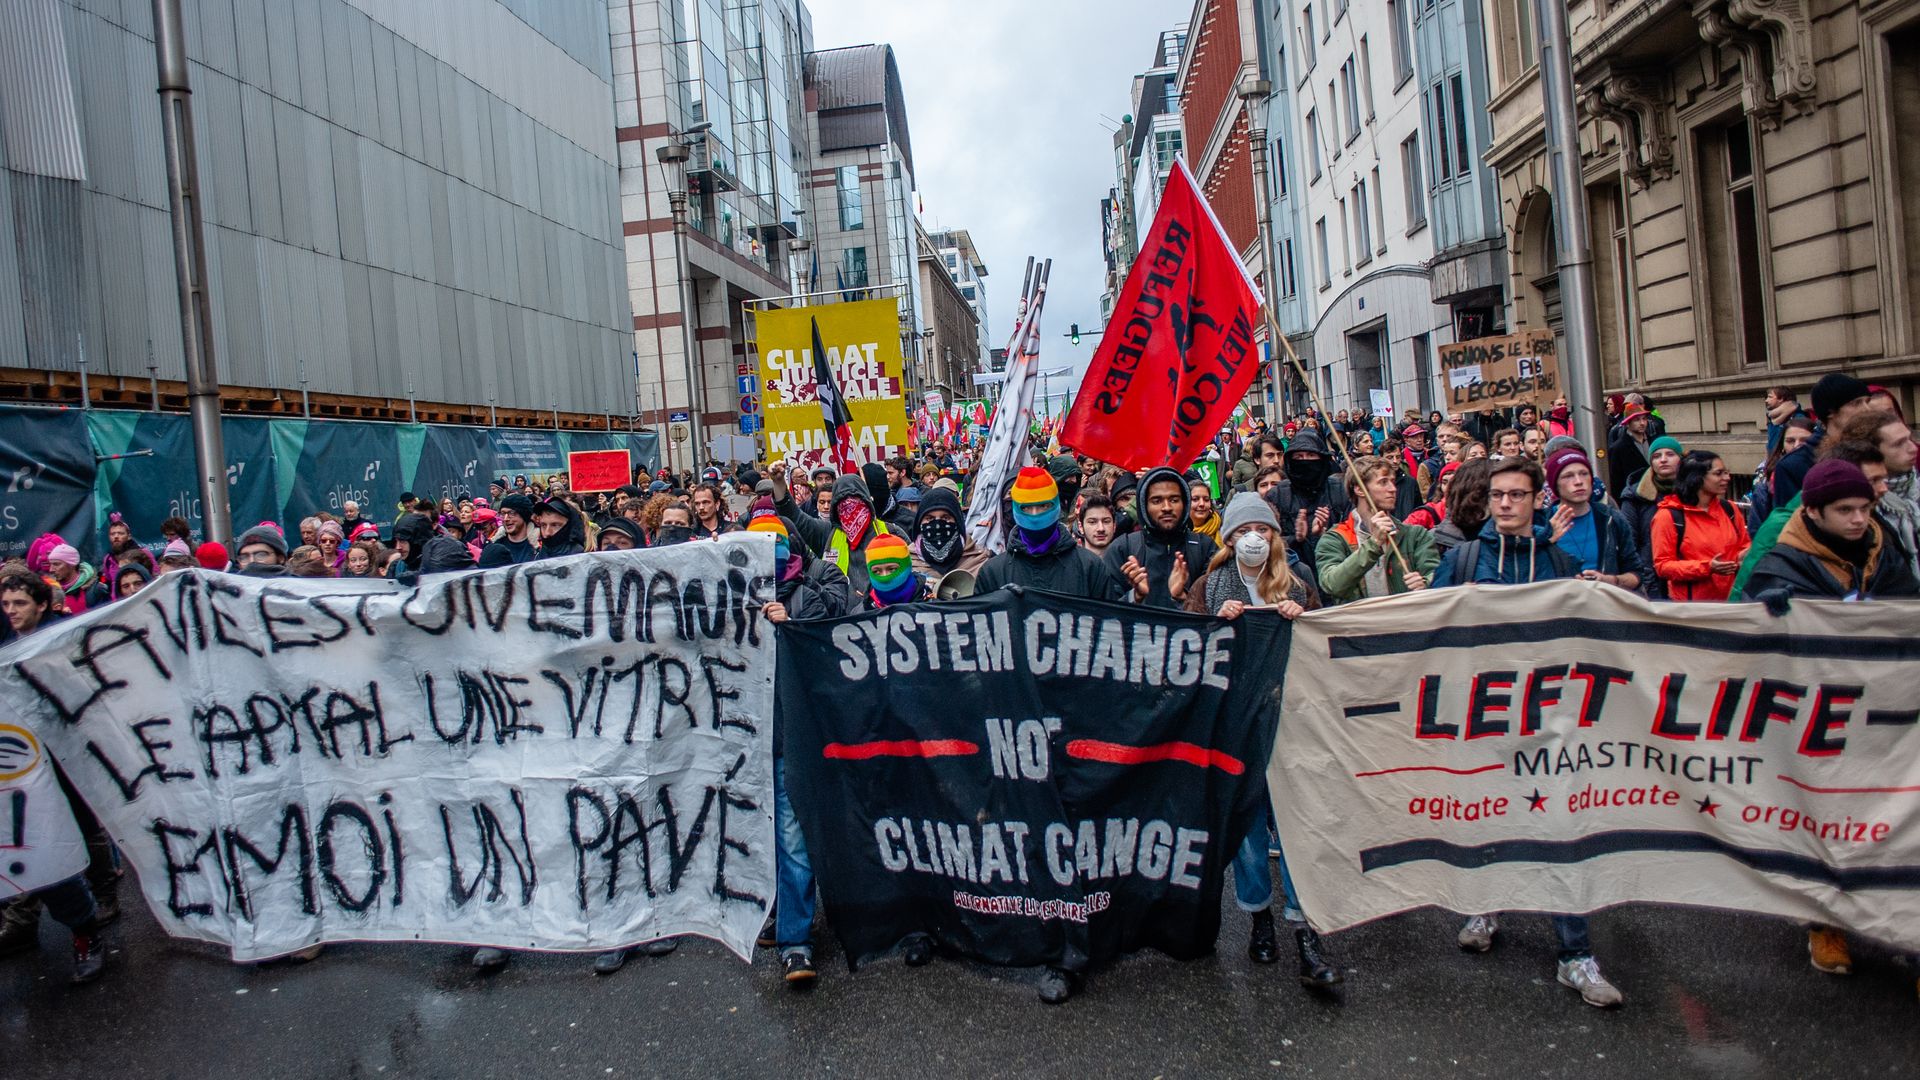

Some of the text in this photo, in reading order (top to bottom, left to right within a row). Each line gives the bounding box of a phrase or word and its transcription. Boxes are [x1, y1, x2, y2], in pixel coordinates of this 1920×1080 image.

[14, 623, 173, 724] LA
[257, 587, 398, 654] EST
[831, 608, 1237, 691] SYSTEM CHANGE
[985, 716, 1063, 782] NOT
[1415, 661, 1865, 757] LEFT LIFE
[85, 717, 196, 801] LE
[1514, 741, 1764, 785] MAASTRICHT
[439, 788, 538, 908] UN
[565, 752, 767, 911] PAVÉ
[874, 817, 1210, 891] CLIMAT CANGE
[1408, 783, 1892, 844] agitate educate organize
